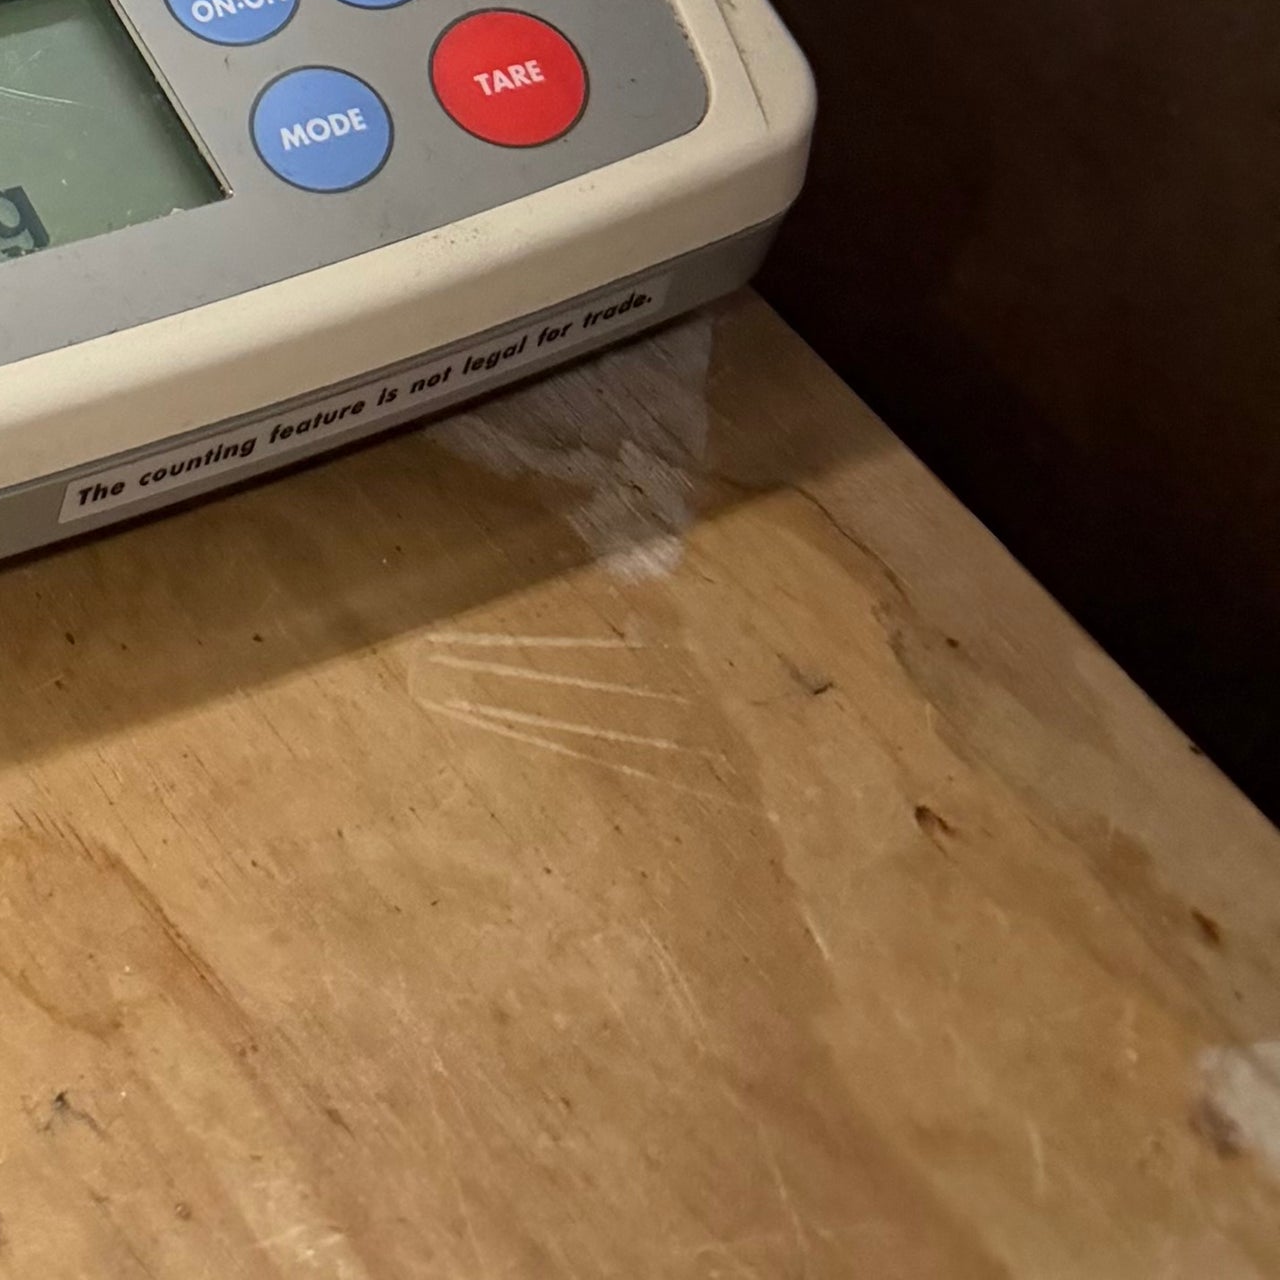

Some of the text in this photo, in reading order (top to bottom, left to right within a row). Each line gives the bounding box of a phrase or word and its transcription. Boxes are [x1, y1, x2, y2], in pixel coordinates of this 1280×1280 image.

[473, 59, 546, 97] TARE
[279, 108, 368, 152] MODE
[77, 291, 654, 507] The counting feature is not legal for trade.
